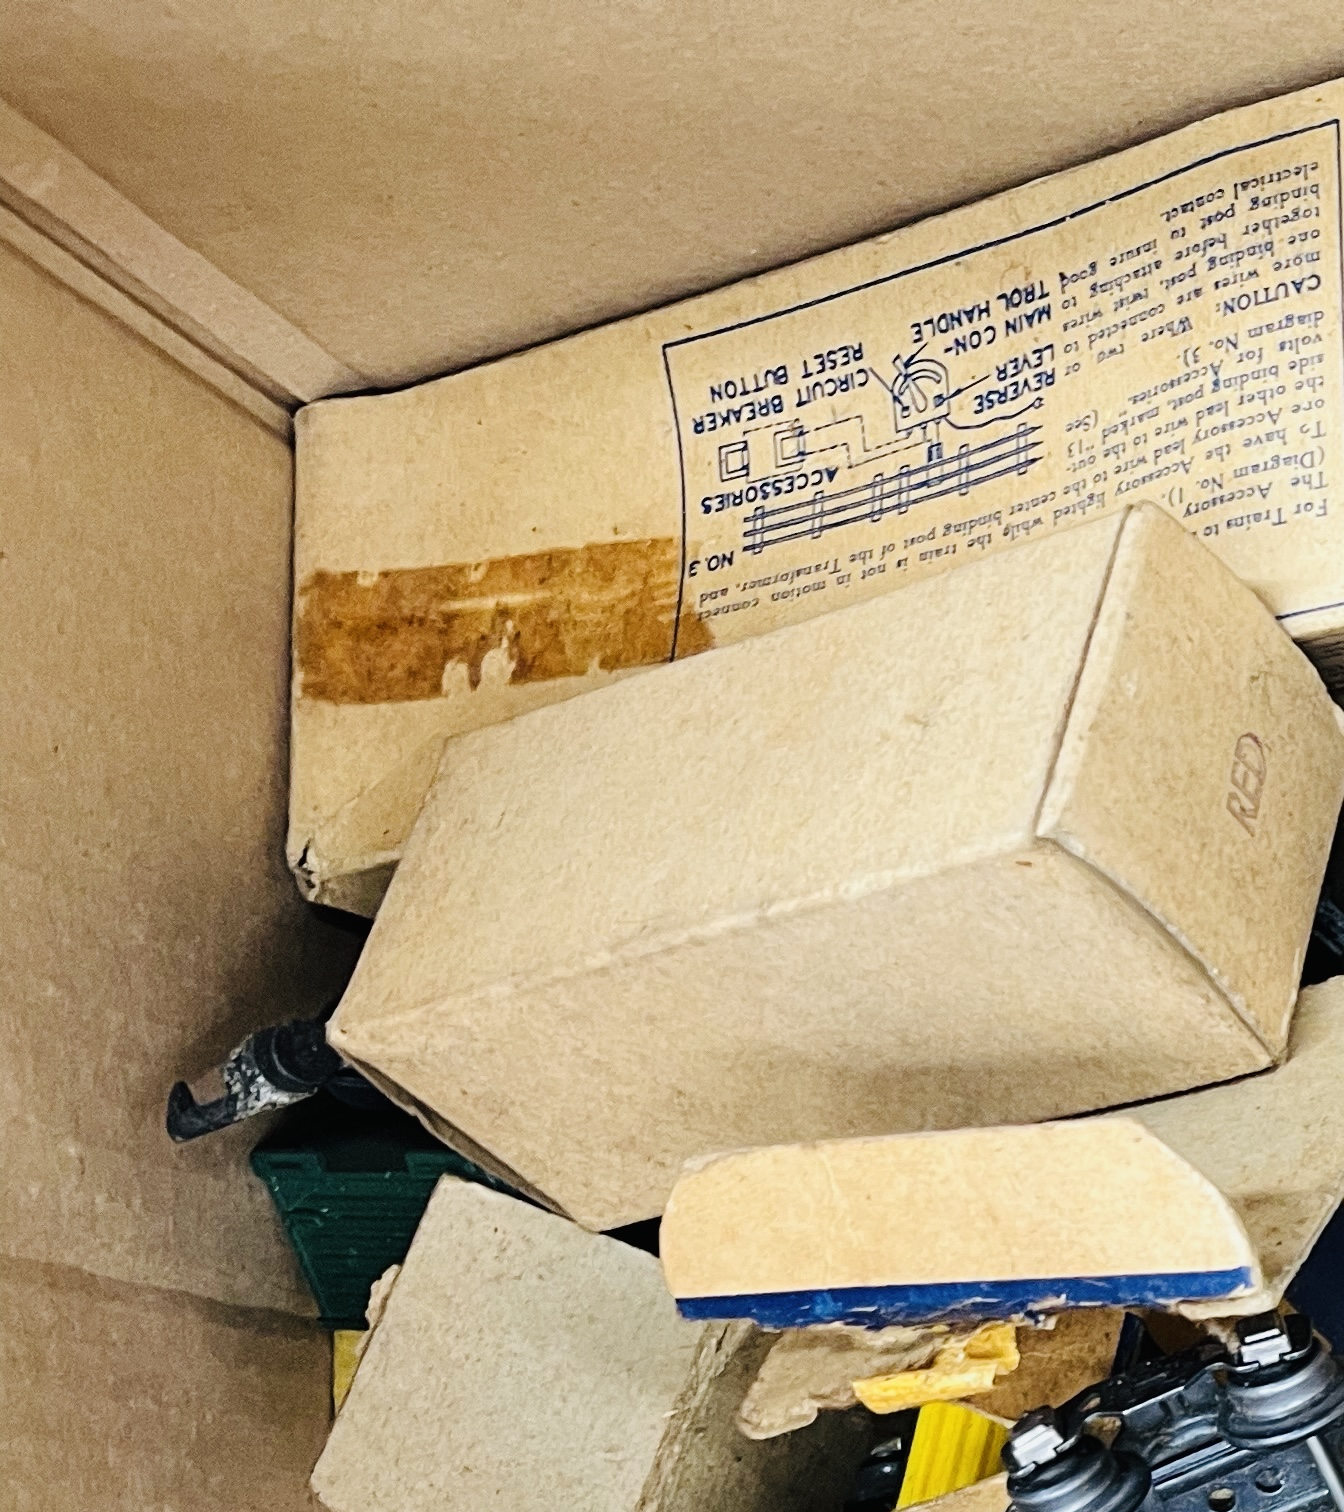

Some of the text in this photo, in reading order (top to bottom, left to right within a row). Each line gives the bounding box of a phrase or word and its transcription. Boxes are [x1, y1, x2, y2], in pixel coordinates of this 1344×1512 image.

[1232, 161, 1318, 203] electrical
[1248, 177, 1319, 212] binding
[1199, 202, 1235, 230] post
[1089, 206, 1319, 299] together before attaching
[1109, 238, 1156, 267] insure
[1207, 240, 1274, 272] binding
[910, 280, 1049, 344] TROL HANDLE
[1087, 250, 1320, 350] more wires are connected
[943, 303, 1051, 356] MAIN CON-
[1062, 309, 1102, 333] wires
[1141, 316, 1192, 343] Where
[1247, 310, 1323, 339] diagram
[1097, 343, 1124, 363] two
[1209, 332, 1238, 353] No.
[1236, 347, 1263, 365] for
[1278, 333, 1322, 355] volts
[709, 341, 863, 404] RESET BUTTON
[995, 343, 1055, 382] LEVER
[1288, 353, 1324, 376] side
[973, 367, 1056, 415] REVERSE
[1210, 364, 1279, 394] binding
[692, 368, 868, 435] CIRCUIT BREAKER
[1065, 409, 1098, 433] (See
[1065, 375, 1324, 473] the other lead wire the out-
[1101, 405, 1160, 443] marked
[1191, 407, 1282, 446] Accessory
[1153, 438, 1185, 462] lead
[1242, 427, 1286, 448] have
[1113, 455, 1147, 475] wire
[1204, 443, 1230, 463] the
[1232, 445, 1324, 479] (Diagram
[1062, 478, 1086, 496] the
[1114, 455, 1194, 497] Accessory
[1196, 473, 1224, 493] No.
[700, 466, 838, 515] ACCESSORIES
[1008, 491, 1056, 515] center
[1182, 470, 1327, 519] The Accessory
[1052, 491, 1105, 526] lighted
[1226, 498, 1328, 531] For Trains
[942, 510, 1001, 537] binding
[879, 542, 895, 560] of
[903, 526, 936, 549] post
[967, 533, 992, 551] the
[688, 550, 734, 577] NO. 3
[849, 548, 873, 566] the
[919, 543, 956, 562] train
[836, 572, 851, 589] in
[860, 563, 885, 580] not
[699, 587, 729, 607] and
[770, 580, 826, 602] motion
[696, 597, 759, 623] connect
